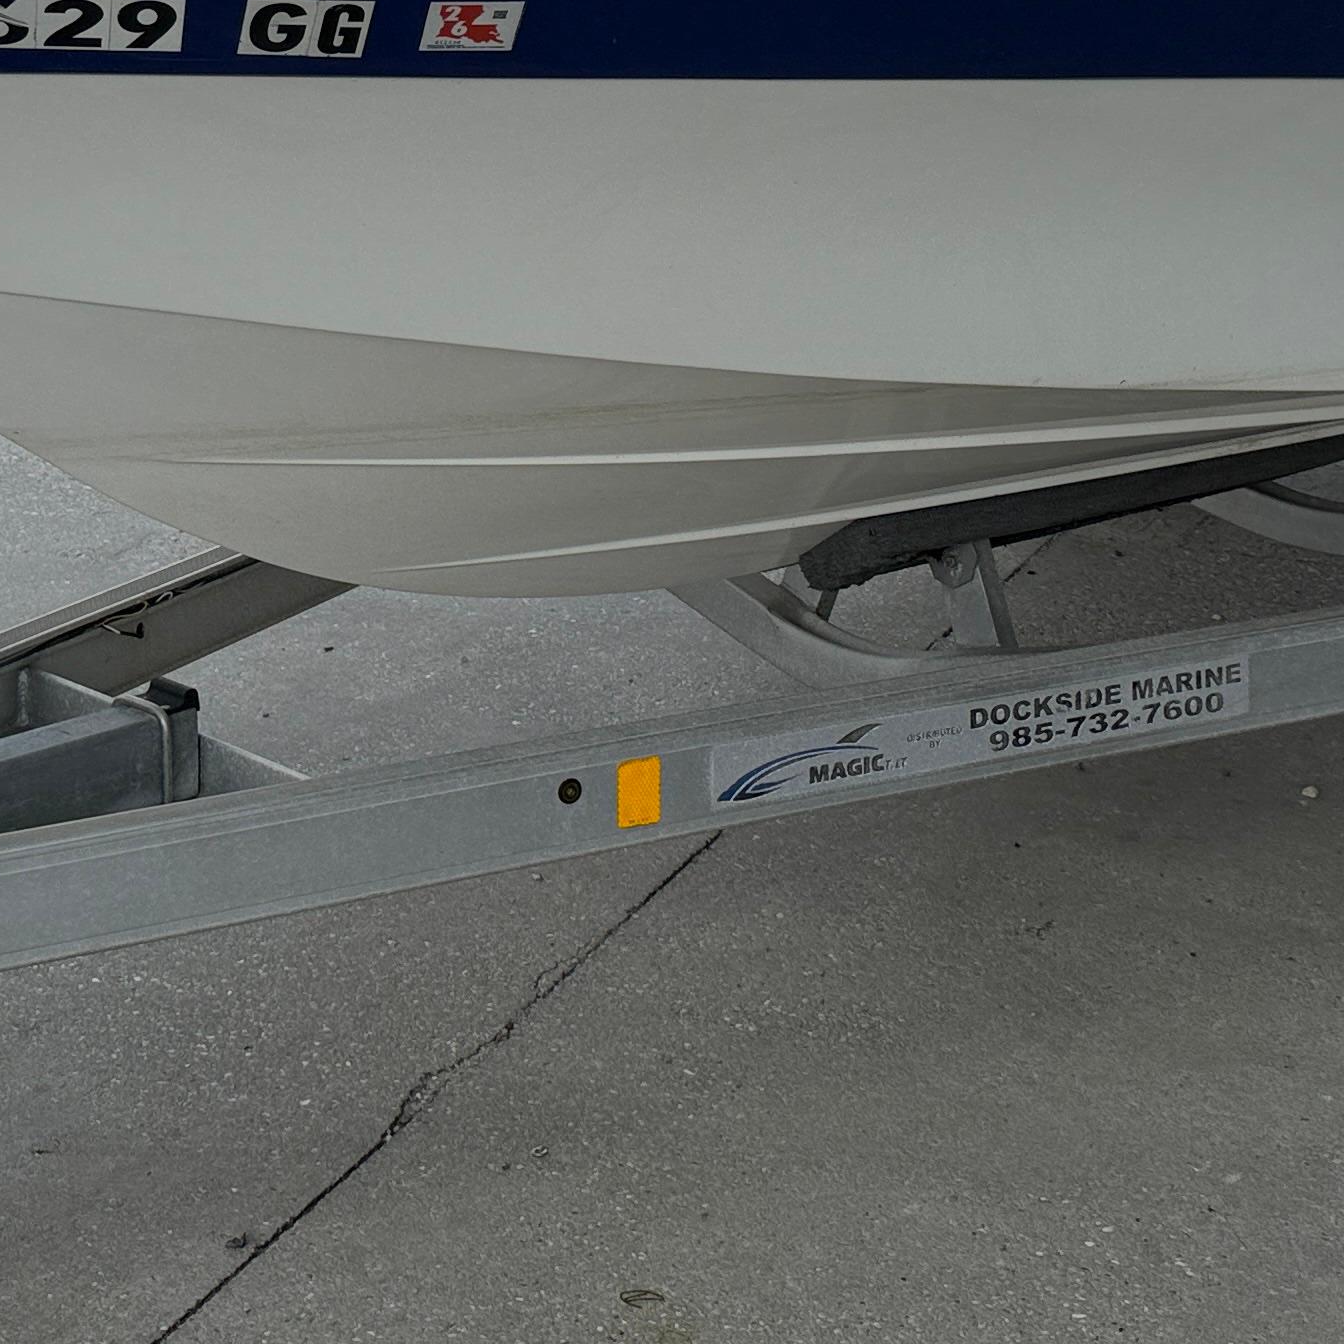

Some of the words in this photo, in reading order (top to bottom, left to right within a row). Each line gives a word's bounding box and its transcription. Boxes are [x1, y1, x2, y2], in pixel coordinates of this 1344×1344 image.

[249, 2, 366, 55] GG
[969, 683, 1122, 730] DOCKSIDE
[1132, 662, 1242, 701] MARINE
[989, 692, 1225, 752] 985-732-7600
[808, 754, 885, 784] MAGIC
